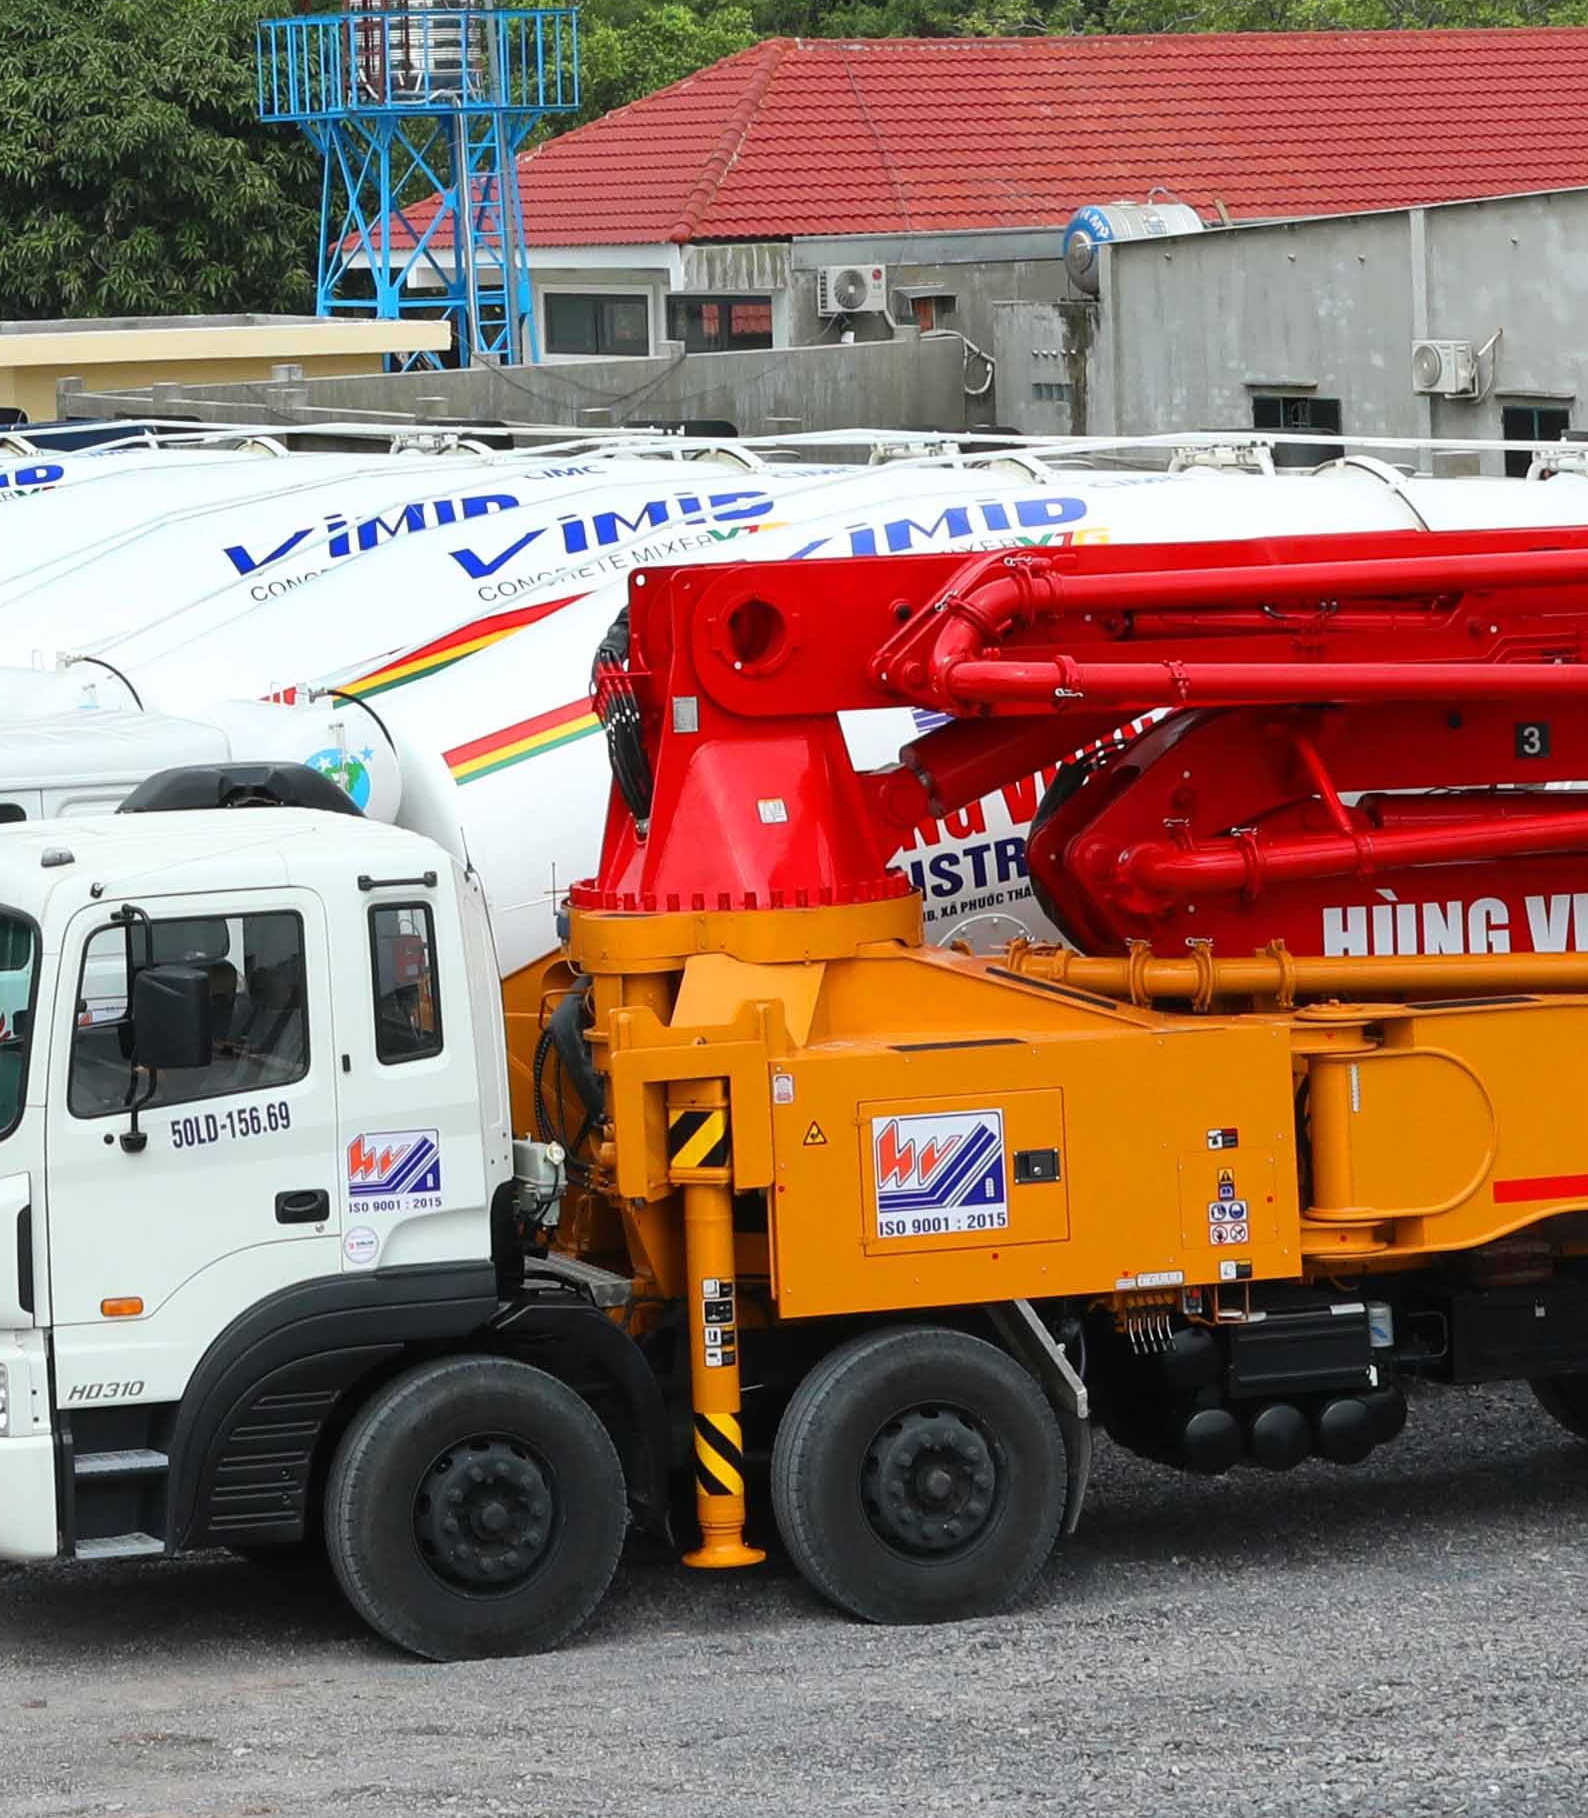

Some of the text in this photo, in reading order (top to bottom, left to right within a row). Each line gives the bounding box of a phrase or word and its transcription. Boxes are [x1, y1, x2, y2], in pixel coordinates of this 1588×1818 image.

[1523, 726, 1541, 755] 3
[1322, 888, 1512, 957] HÙNG
[170, 1101, 291, 1149] 50LD-156.69
[349, 1202, 369, 1214] ISO
[373, 1200, 401, 1212] 9001
[413, 1197, 442, 1209] 2015
[879, 1220, 906, 1236] ISO
[912, 1217, 950, 1233] 9001
[967, 1212, 1006, 1228] 2015
[67, 1380, 145, 1400] HD310
